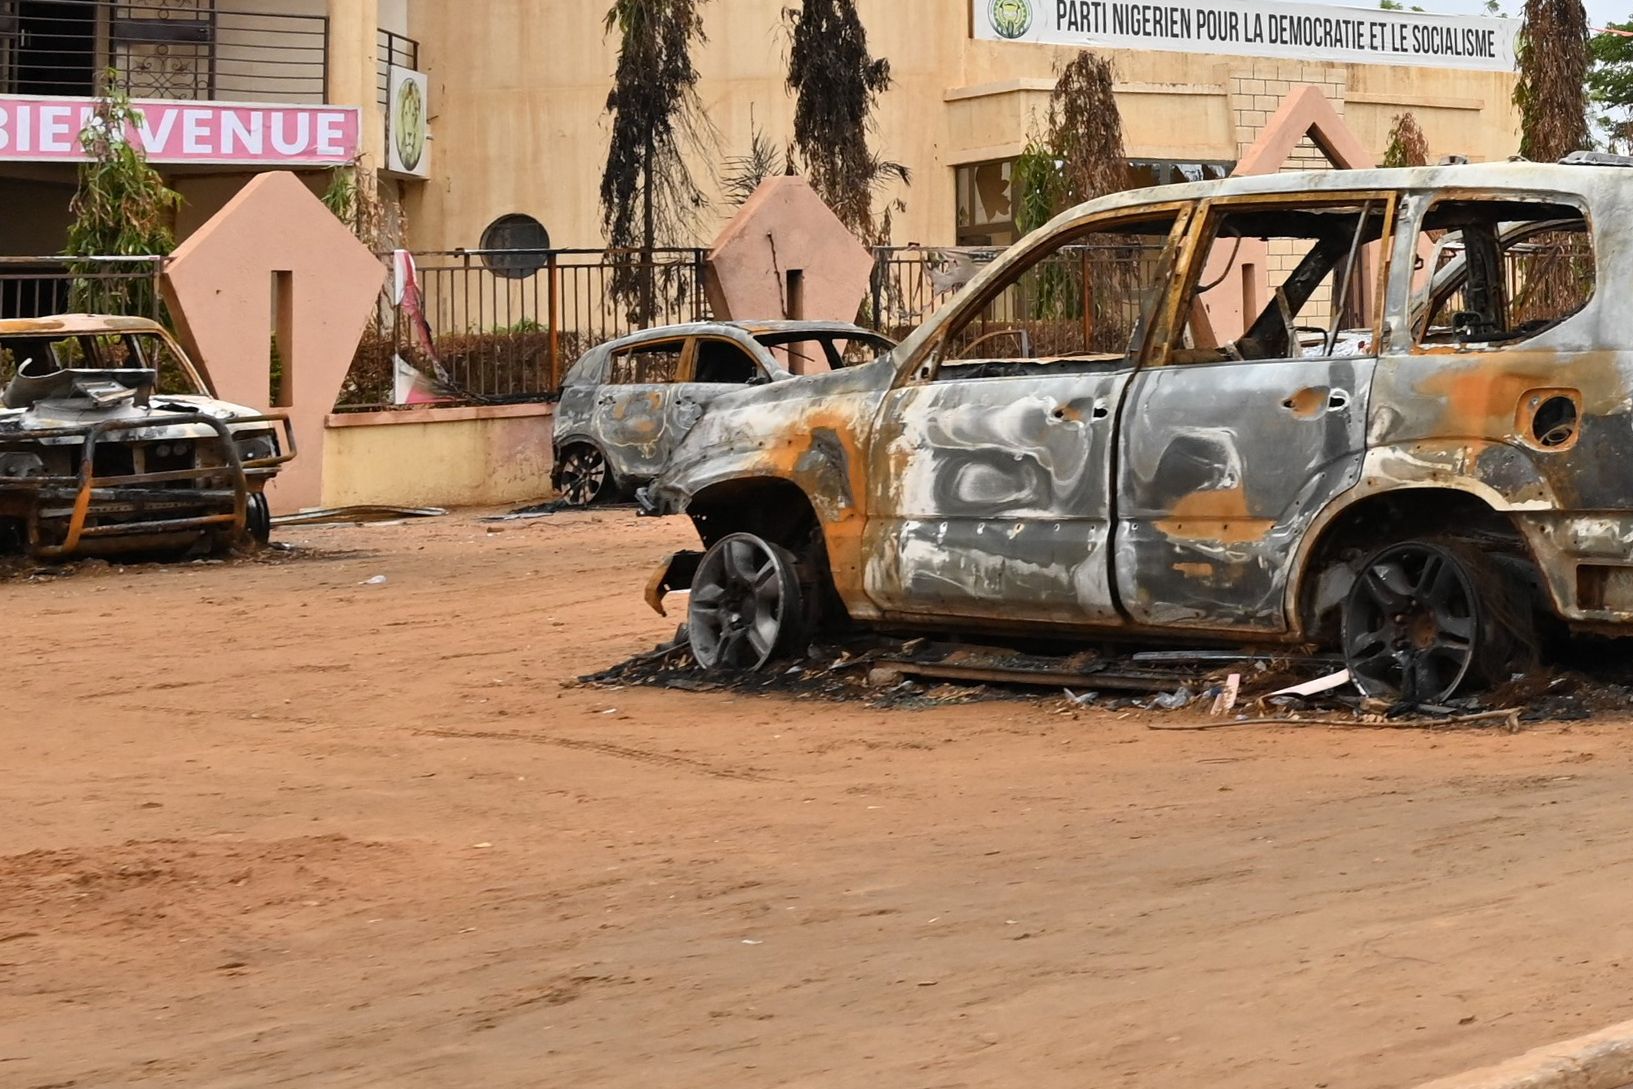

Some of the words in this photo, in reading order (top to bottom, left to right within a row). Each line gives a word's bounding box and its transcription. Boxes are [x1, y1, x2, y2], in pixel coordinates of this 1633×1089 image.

[1112, 2, 1192, 40] NIGERIEN
[1196, 8, 1240, 42] POUR
[1243, 11, 1264, 44] LA
[1268, 13, 1366, 50] DEMOCRATIE
[1370, 21, 1387, 52] ET
[1391, 23, 1409, 53] LE
[1412, 24, 1496, 58] SOCIALISME
